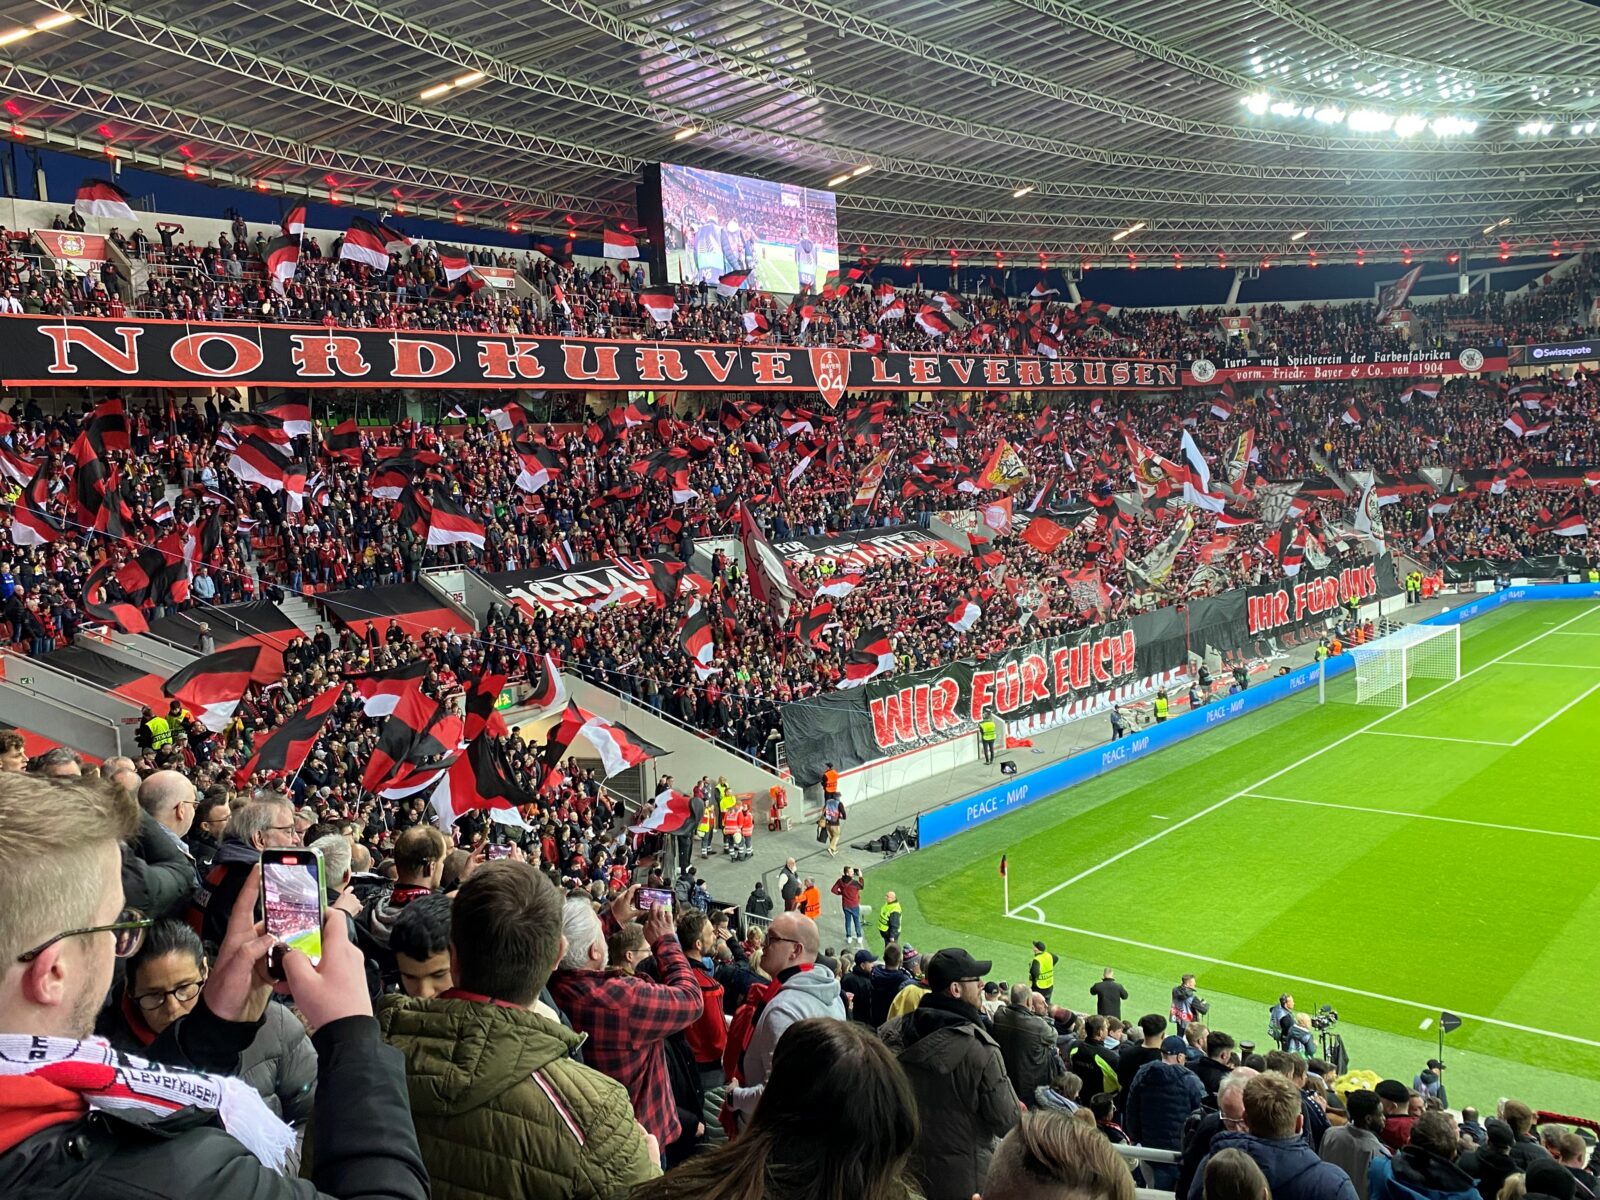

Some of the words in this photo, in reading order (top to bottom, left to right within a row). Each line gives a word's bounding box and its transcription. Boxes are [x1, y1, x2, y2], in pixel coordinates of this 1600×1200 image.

[37, 325, 793, 384] NORDKURVE
[871, 356, 1177, 385] LEVERKUSEN
[1223, 357, 1251, 369] Turn-
[1260, 356, 1279, 367] und
[1287, 354, 1342, 368] Spielverein
[1350, 352, 1366, 364] der
[1374, 350, 1451, 364] Farbenfabriken
[1544, 346, 1592, 357] Swissquote
[1237, 370, 1265, 379] vorm.
[1314, 366, 1343, 379] Bayer
[1367, 364, 1384, 376] Co.
[1392, 365, 1409, 375] von
[1419, 362, 1443, 374] 1904
[818, 374, 845, 391] 04
[773, 541, 810, 553] FÜR
[1247, 589, 1290, 635] IHR
[1294, 575, 1340, 621] FÜR
[1339, 562, 1378, 603] UNS
[869, 677, 965, 748] WIR
[970, 654, 1050, 722] FÜR
[1051, 629, 1136, 697] EUCH
[1206, 706, 1226, 723] PEACE
[1102, 745, 1126, 765] PEACE
[1131, 736, 1150, 753] МИР
[966, 797, 998, 821] PEACE
[1006, 784, 1029, 805] МИР
